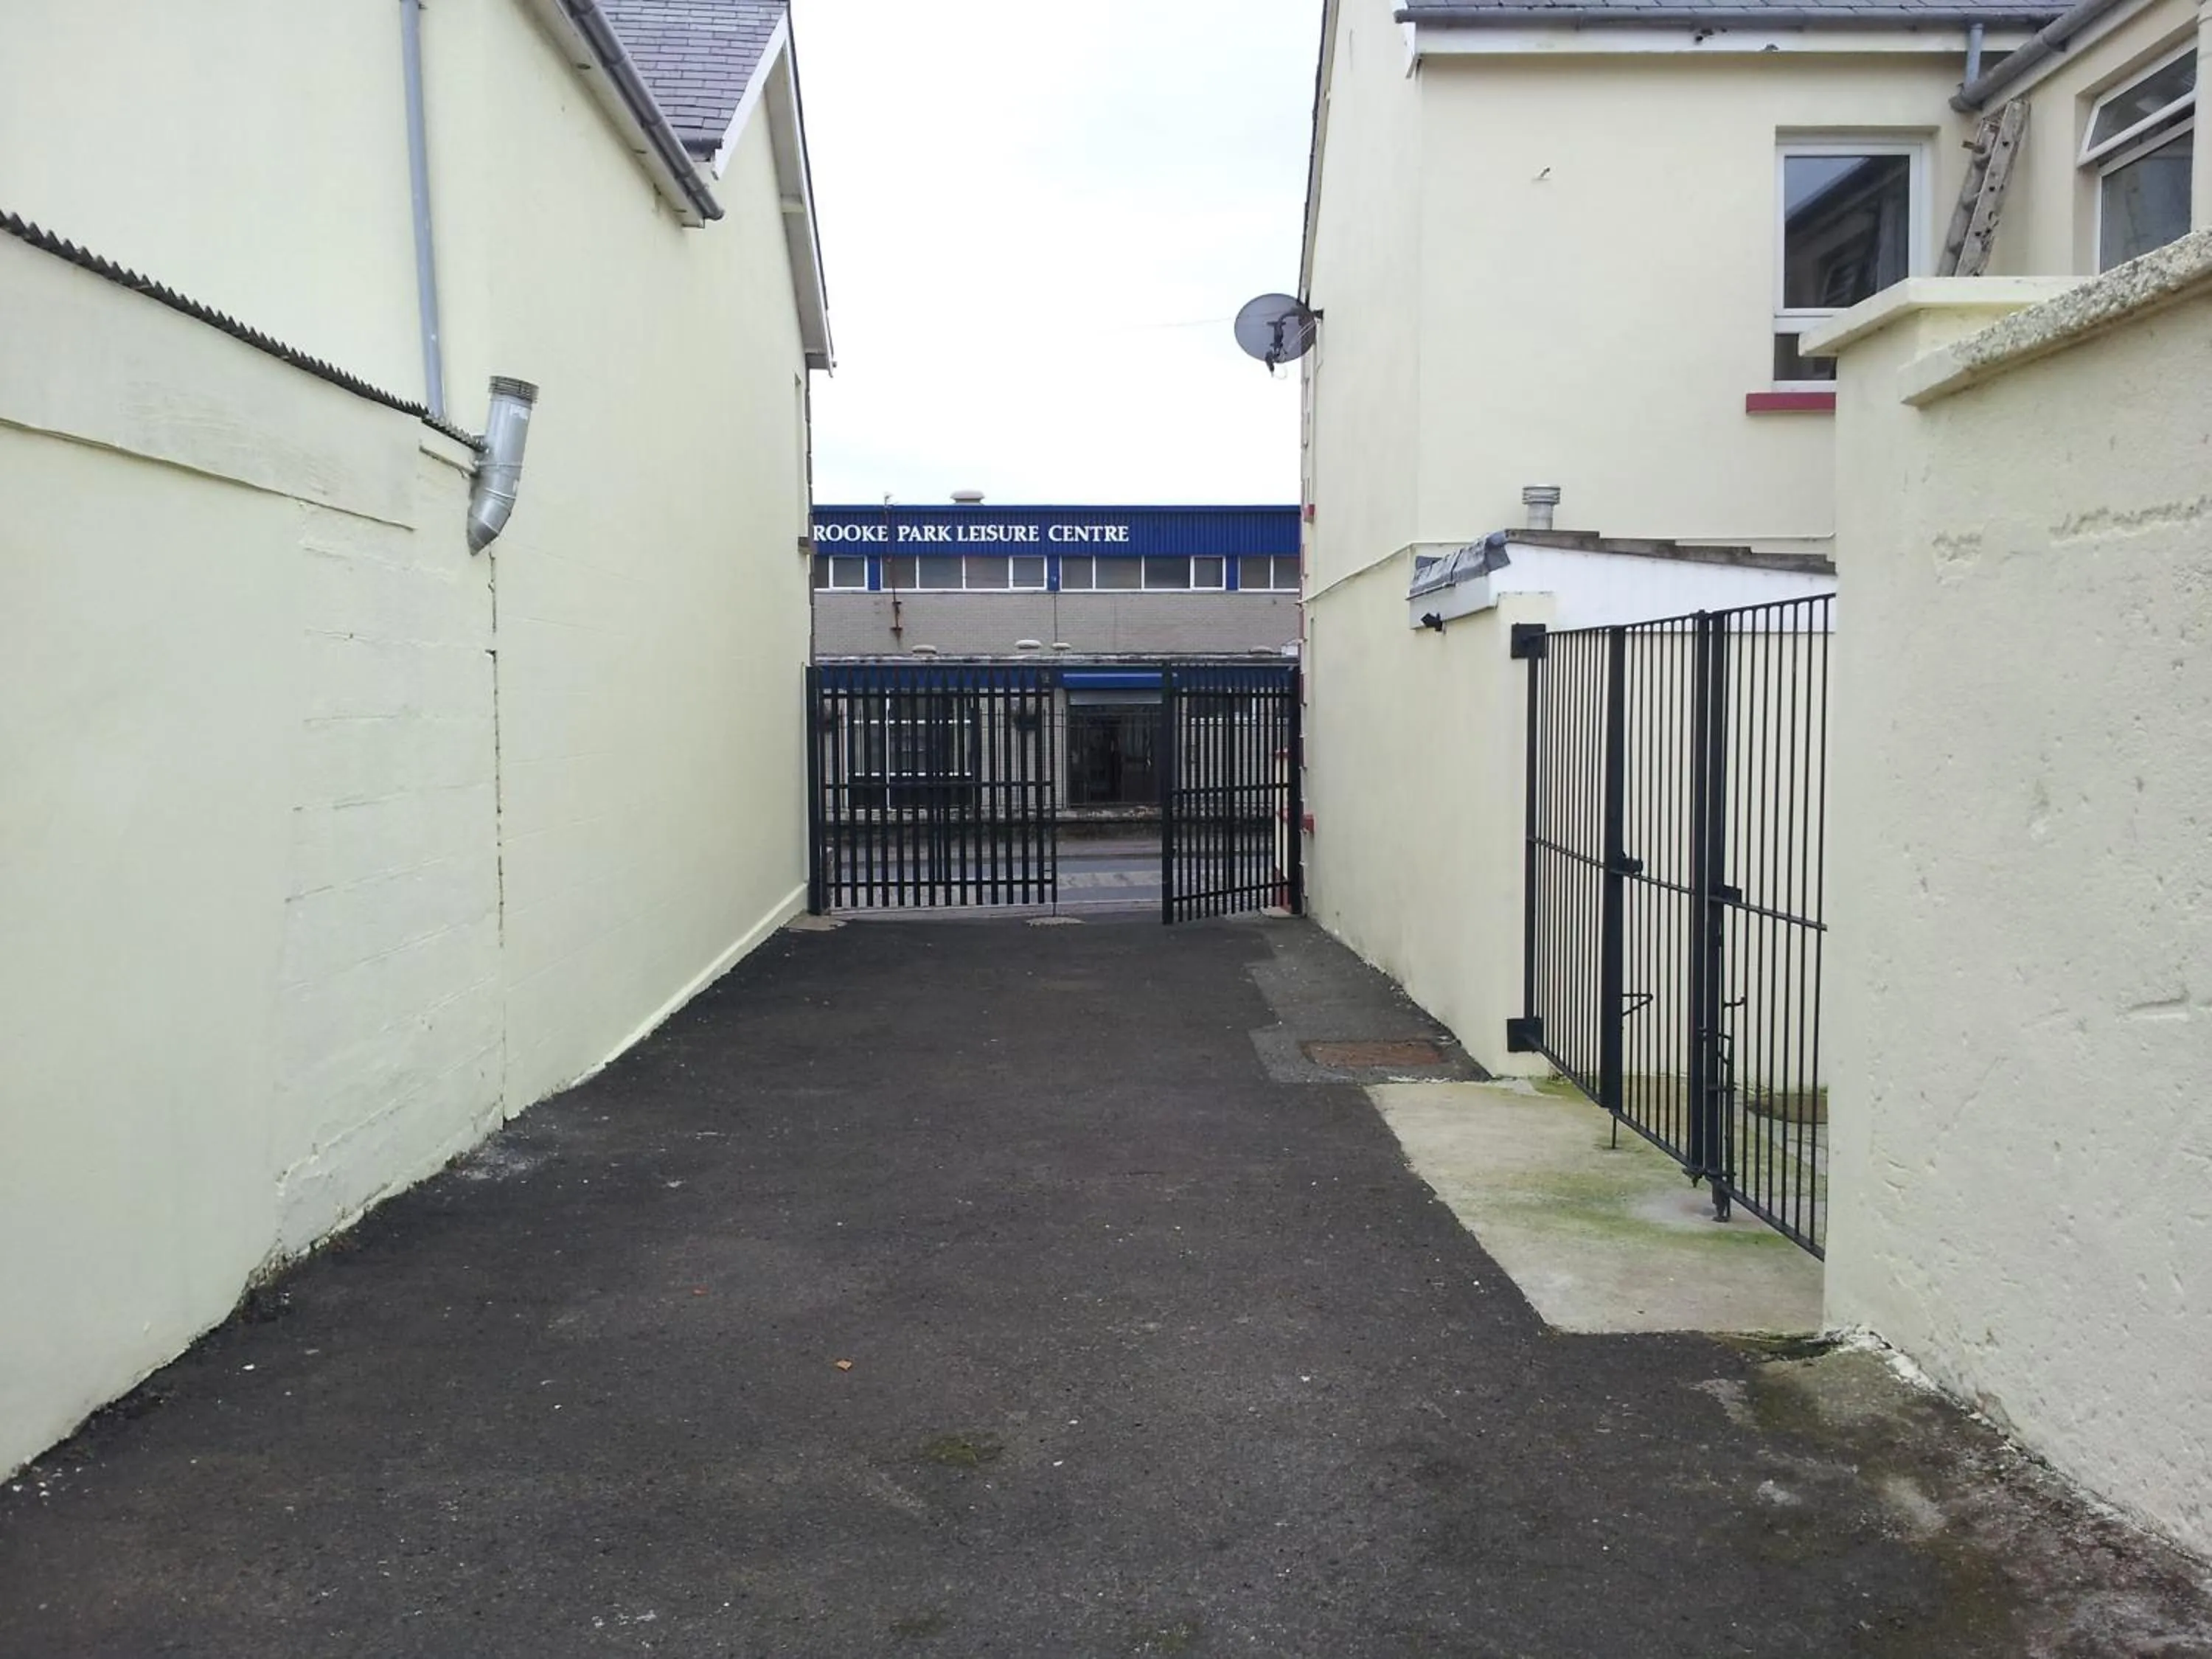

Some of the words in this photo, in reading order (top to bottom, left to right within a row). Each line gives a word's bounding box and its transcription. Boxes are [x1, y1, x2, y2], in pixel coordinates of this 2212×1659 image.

[897, 524, 952, 542] PARK
[957, 524, 1039, 542] LEISURE
[1048, 524, 1129, 542] CENTRE
